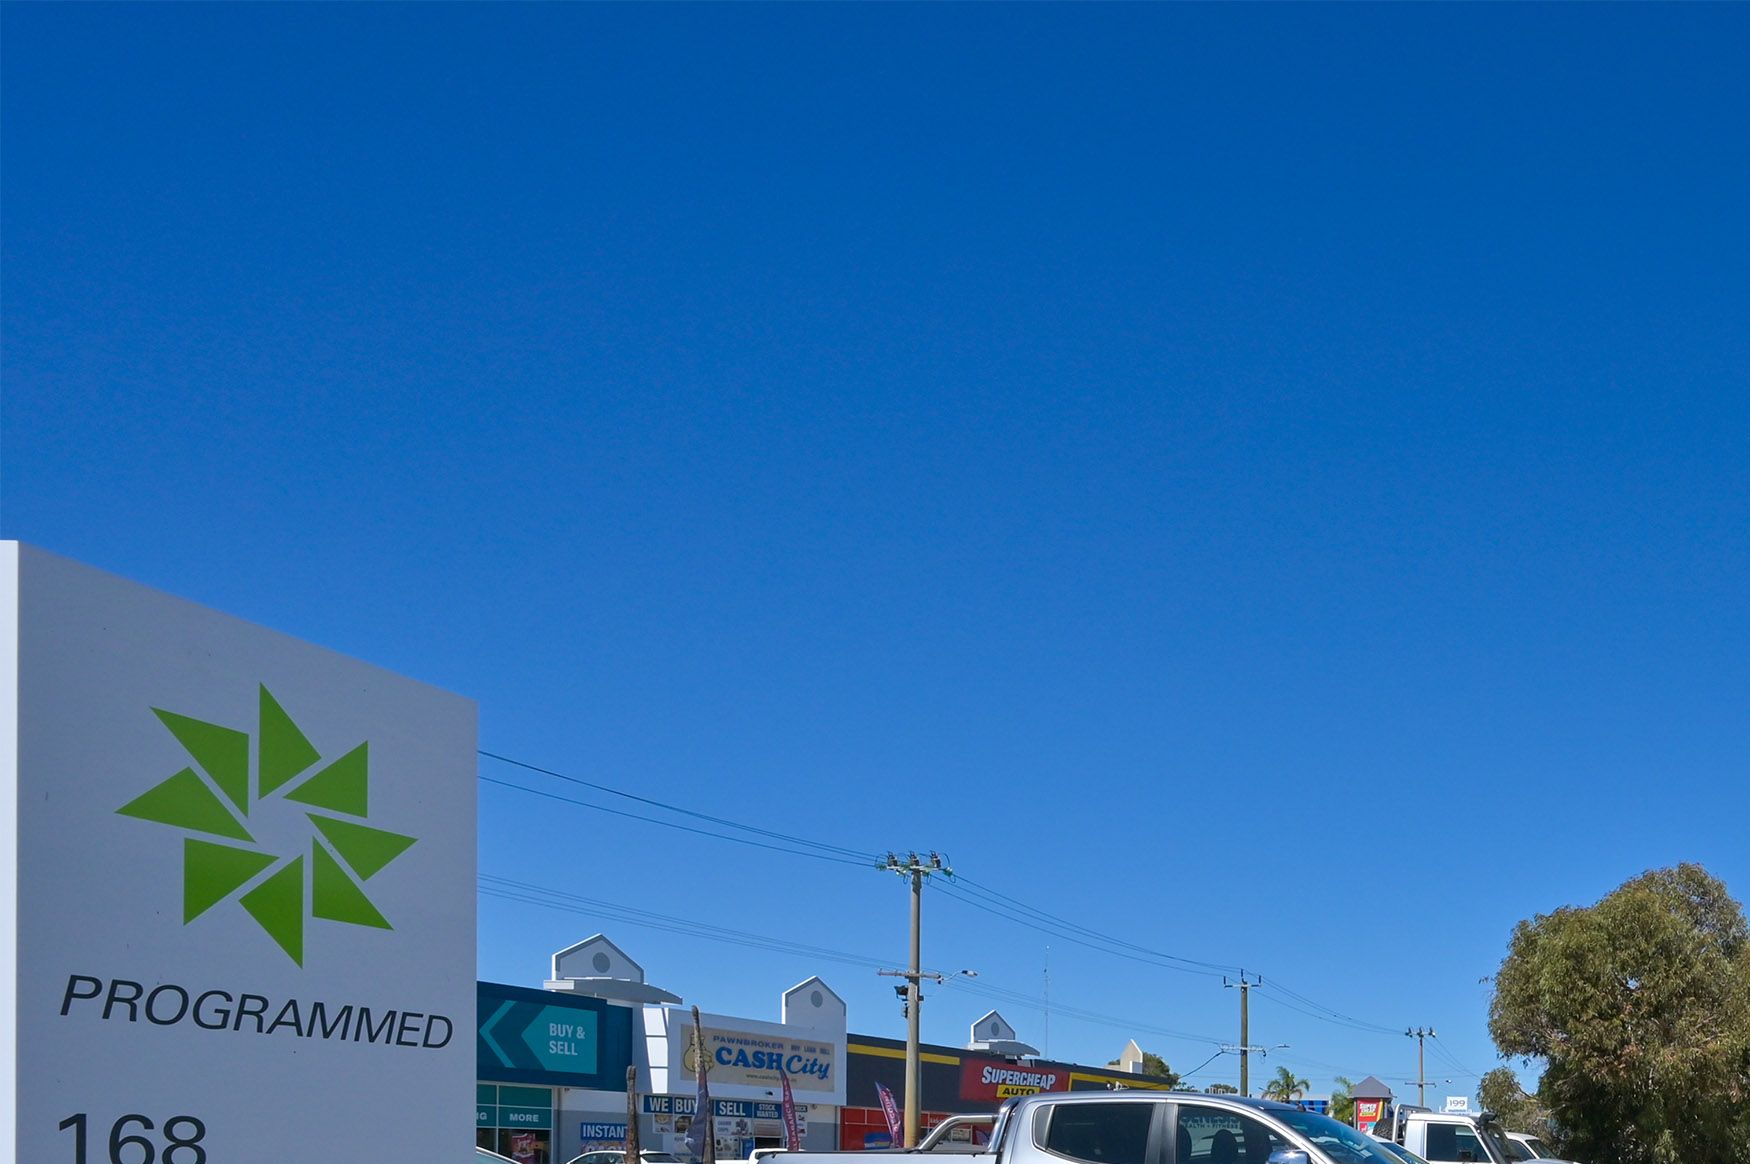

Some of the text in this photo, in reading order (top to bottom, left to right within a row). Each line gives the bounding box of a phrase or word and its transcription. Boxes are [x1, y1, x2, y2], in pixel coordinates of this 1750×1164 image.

[59, 973, 454, 1050] PROGRAMMED
[549, 1022, 586, 1040] BUY &
[549, 1040, 578, 1056] SELL
[713, 1035, 784, 1050] PAWNBROKER
[715, 1046, 831, 1081] CASH City
[981, 1065, 1056, 1090] SUPERCHEAP
[1002, 1087, 1036, 1097] AUTO
[649, 1097, 669, 1112] WE
[719, 1102, 746, 1117] SELL
[509, 1112, 539, 1123] MORE
